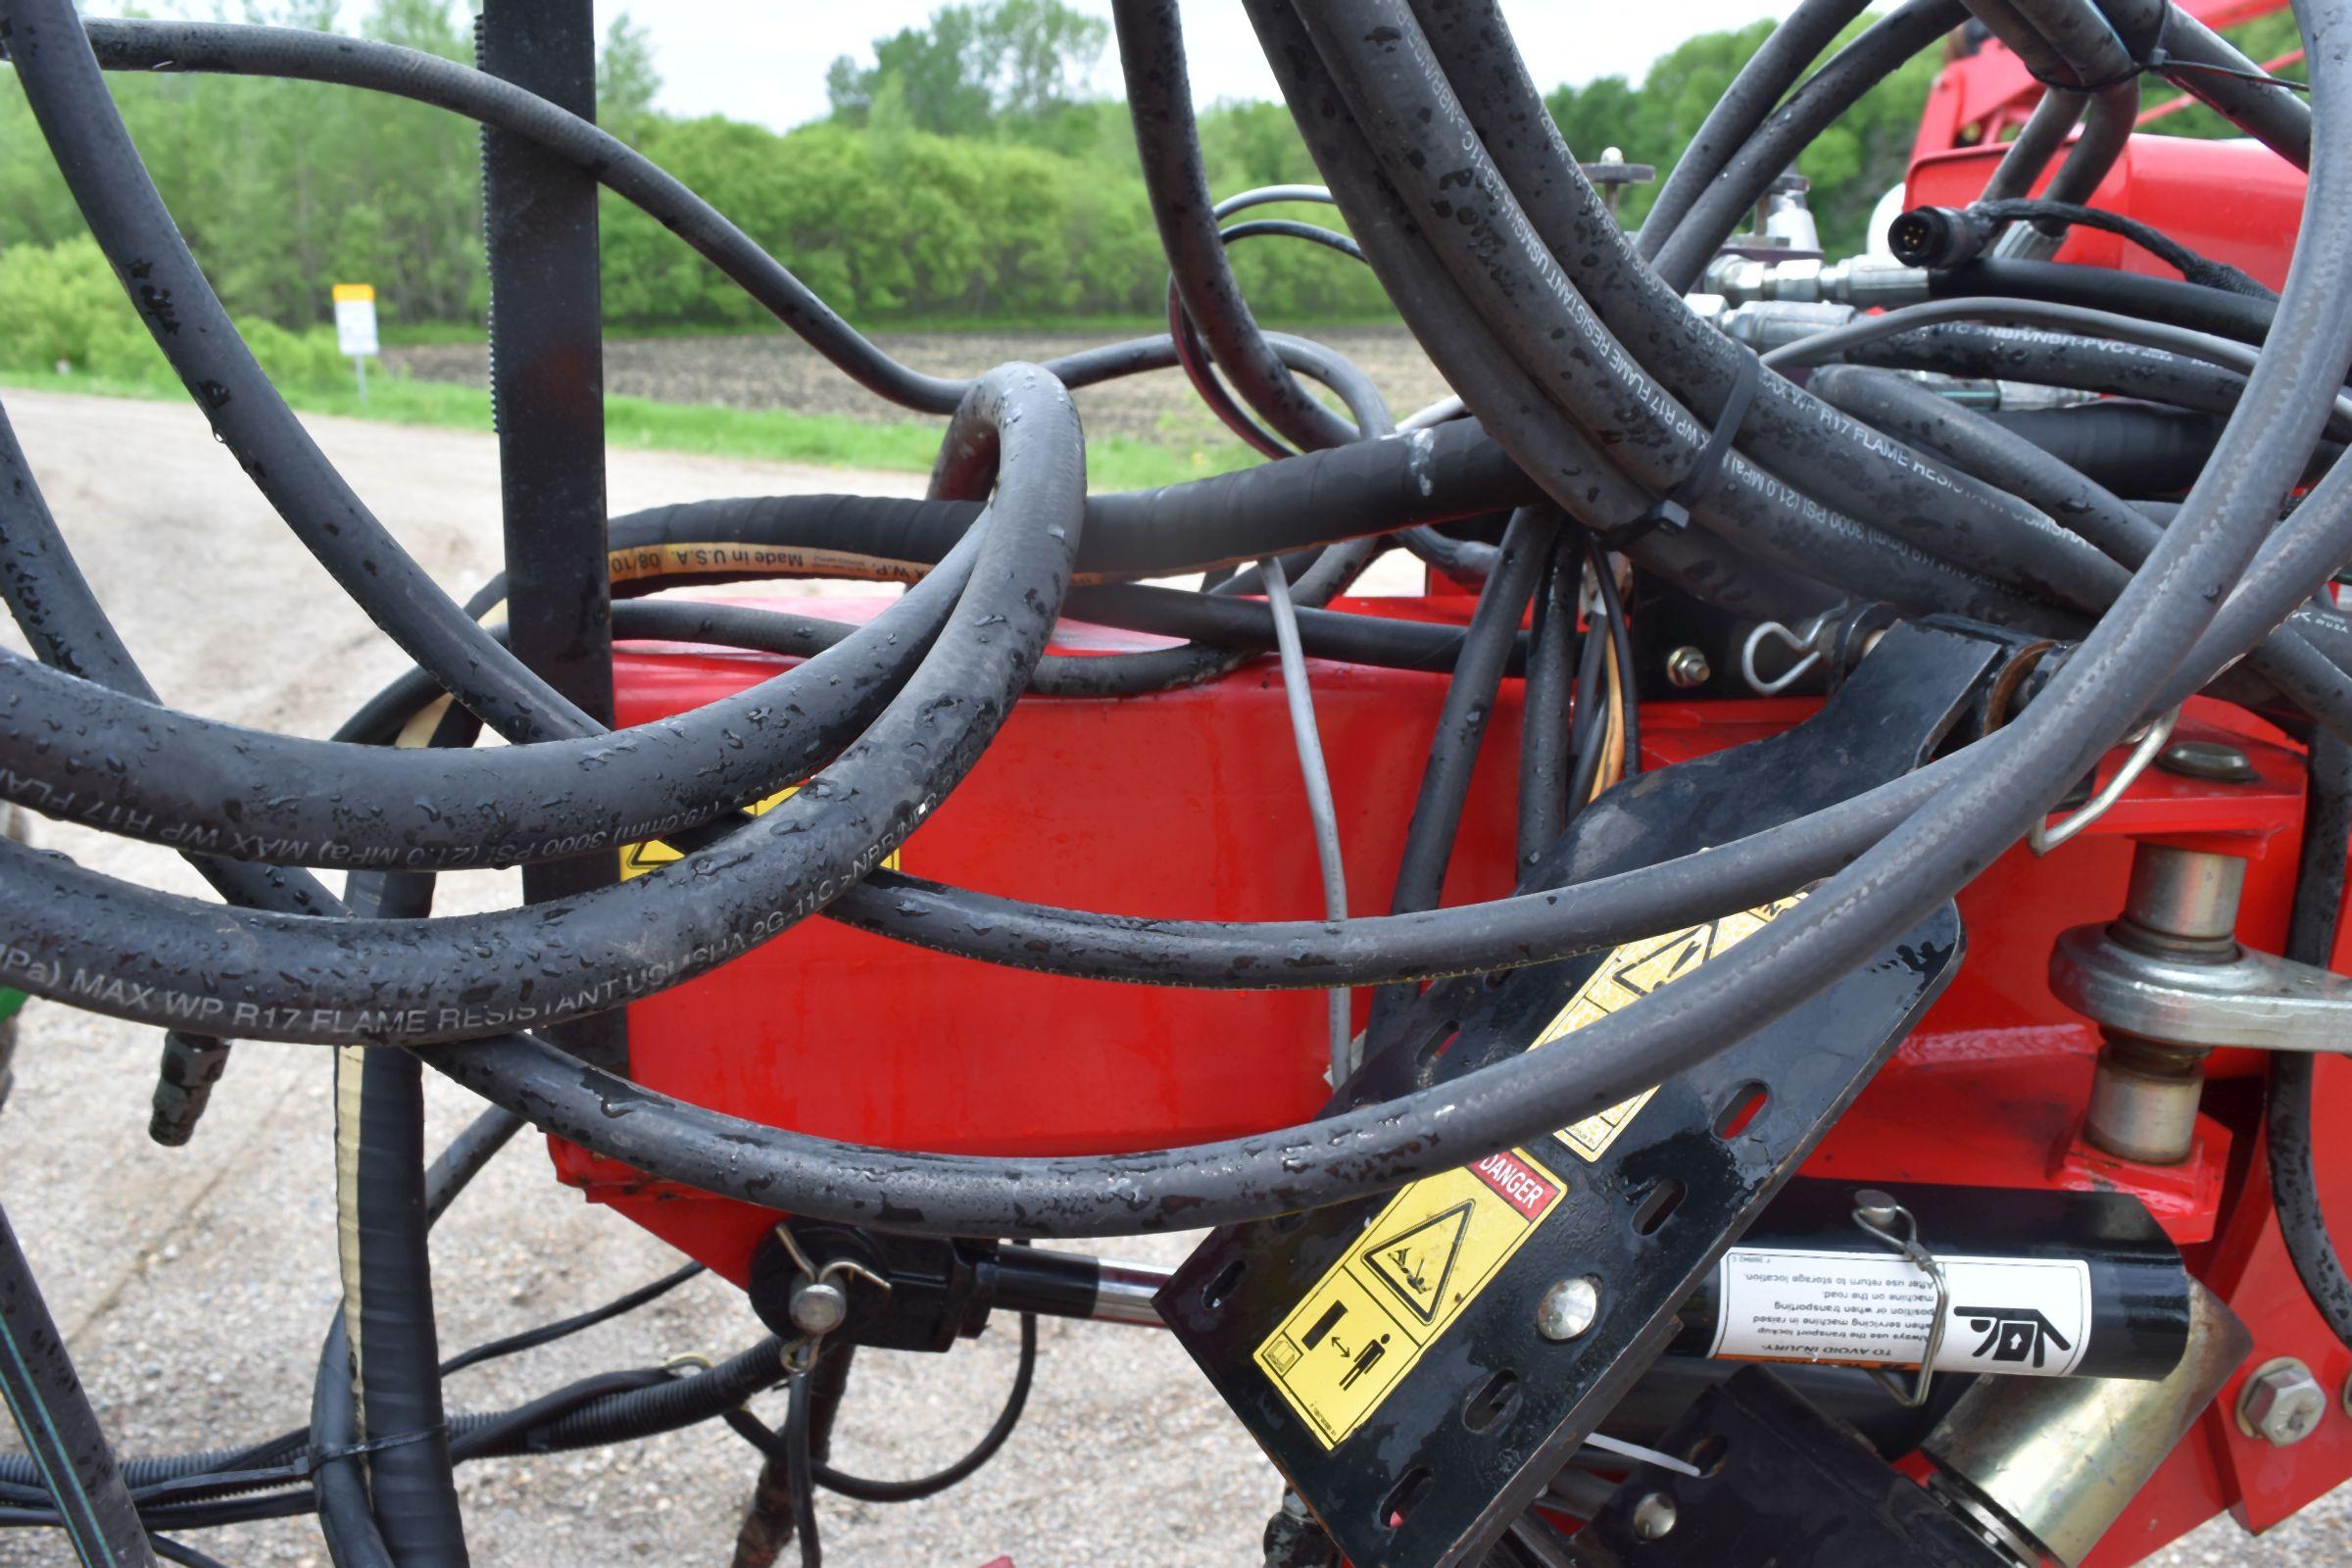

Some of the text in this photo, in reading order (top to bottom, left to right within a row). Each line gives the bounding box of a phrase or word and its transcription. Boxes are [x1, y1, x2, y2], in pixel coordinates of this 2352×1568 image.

[1545, 270, 1699, 448] WP R17 FLAME RESISTANT
[1819, 407, 1851, 435] R17
[1852, 426, 1909, 467] FLAME
[1800, 497, 1828, 525] PSI
[611, 551, 662, 574] 08/10
[669, 549, 727, 566] U.S.A.
[731, 550, 751, 563] in
[755, 550, 805, 567] Made
[82, 800, 154, 832] R17
[159, 820, 220, 850] WP
[229, 829, 311, 861] MAX
[541, 831, 608, 858] 3000
[69, 966, 156, 1010] MAX
[164, 989, 224, 1021] WP
[231, 1001, 303, 1030] R17
[309, 1007, 428, 1035] FLAME
[436, 976, 624, 1032] RESISTANT
[1478, 1153, 1544, 1209] DANGER
[1743, 1272, 1790, 1284] location.
[1791, 1274, 1834, 1285] storage
[1849, 1278, 1884, 1287] return
[1907, 1280, 1935, 1291] After
[1821, 1290, 1849, 1299] road.
[1851, 1292, 1869, 1300] the
[1888, 1293, 1935, 1302] machine
[1774, 1300, 1841, 1313] transporting
[1843, 1305, 1873, 1314] when
[1890, 1305, 1936, 1316] position
[1752, 1314, 1788, 1325] raised
[1802, 1317, 1849, 1326] machine
[1850, 1318, 1901, 1330] servicing
[1757, 1327, 1793, 1337] lockup
[1796, 1330, 1847, 1339] transport
[1822, 1346, 1871, 1356] AVOID
[1874, 1347, 1892, 1357] TO
